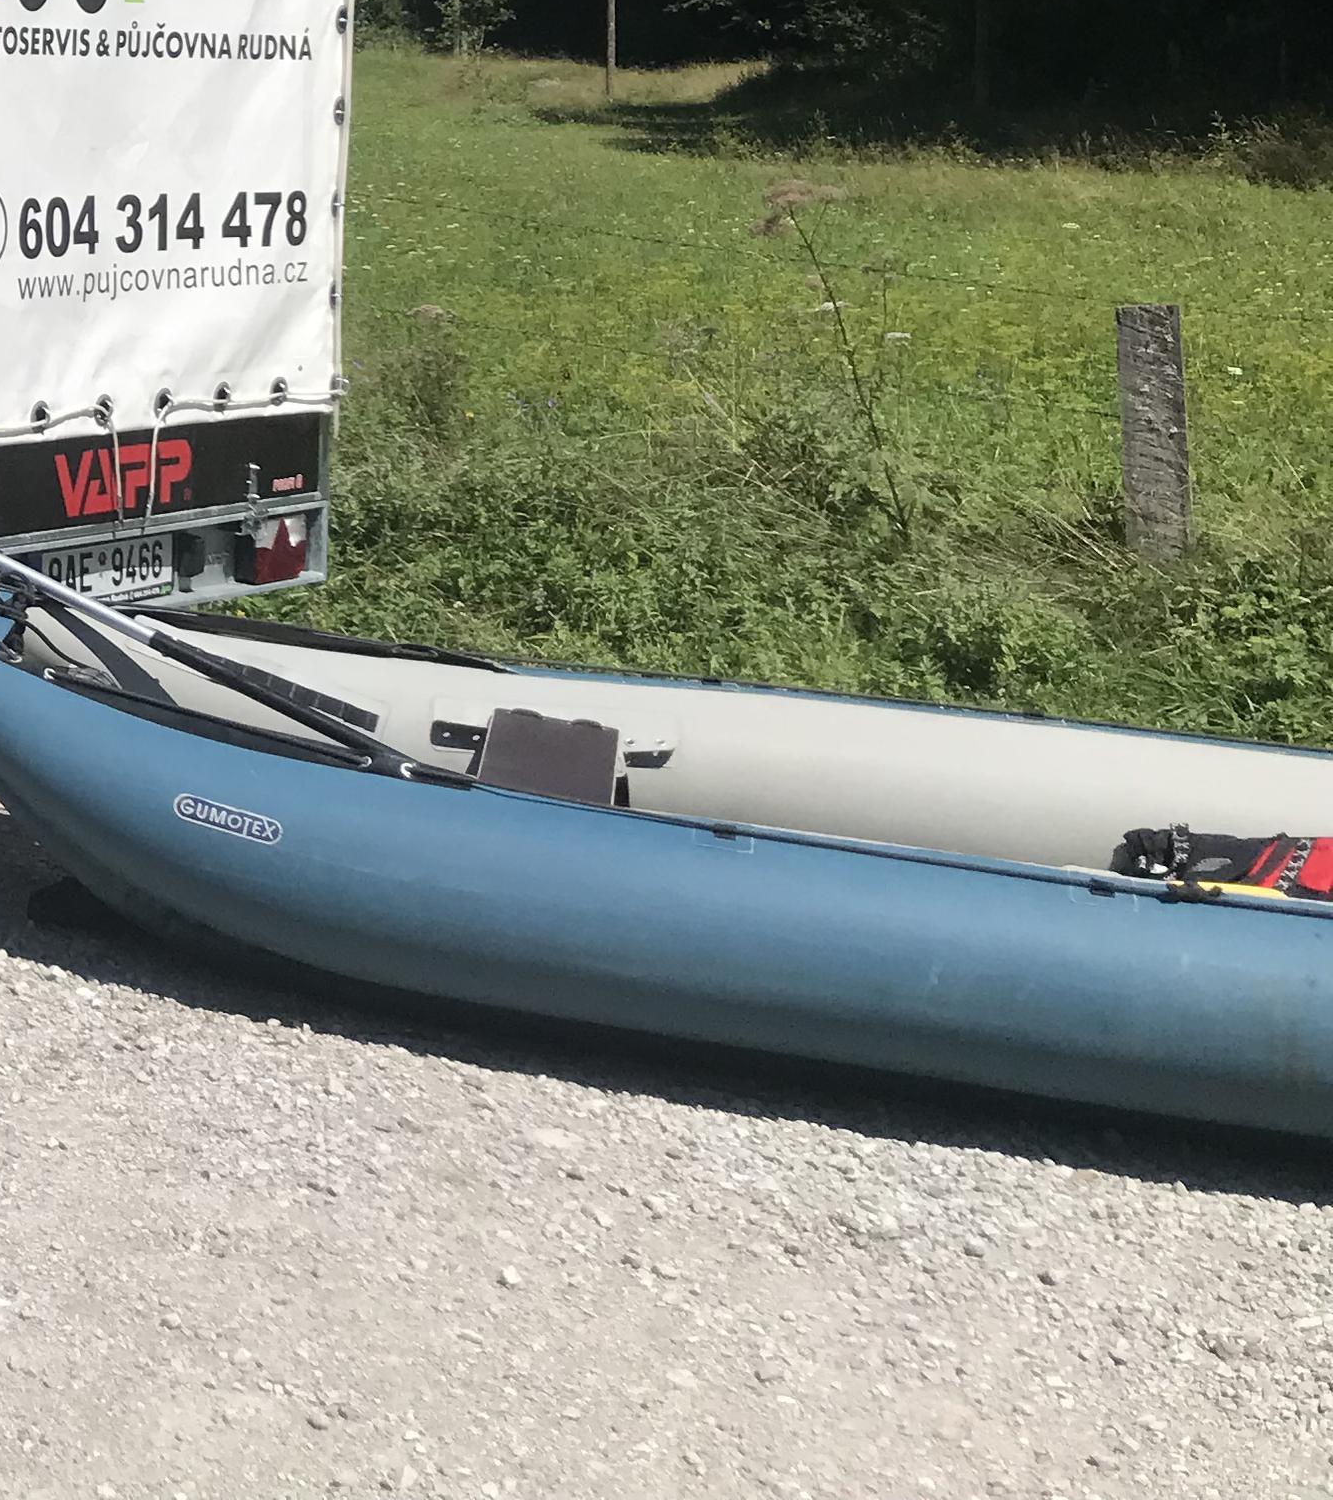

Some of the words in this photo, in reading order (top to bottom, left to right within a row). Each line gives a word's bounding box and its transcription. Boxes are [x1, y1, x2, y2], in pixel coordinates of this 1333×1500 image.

[96, 29, 111, 57] &
[116, 21, 232, 59] PŮJČOVNA
[237, 28, 313, 60] RUDNÁ
[18, 197, 99, 259] 604
[114, 193, 205, 254] 314
[221, 190, 308, 248] 478
[17, 258, 309, 302] www.pujcovnarudna.cz
[54, 439, 193, 518] VAPP
[111, 540, 163, 587] 9466
[179, 799, 276, 840] GUMOTEX
